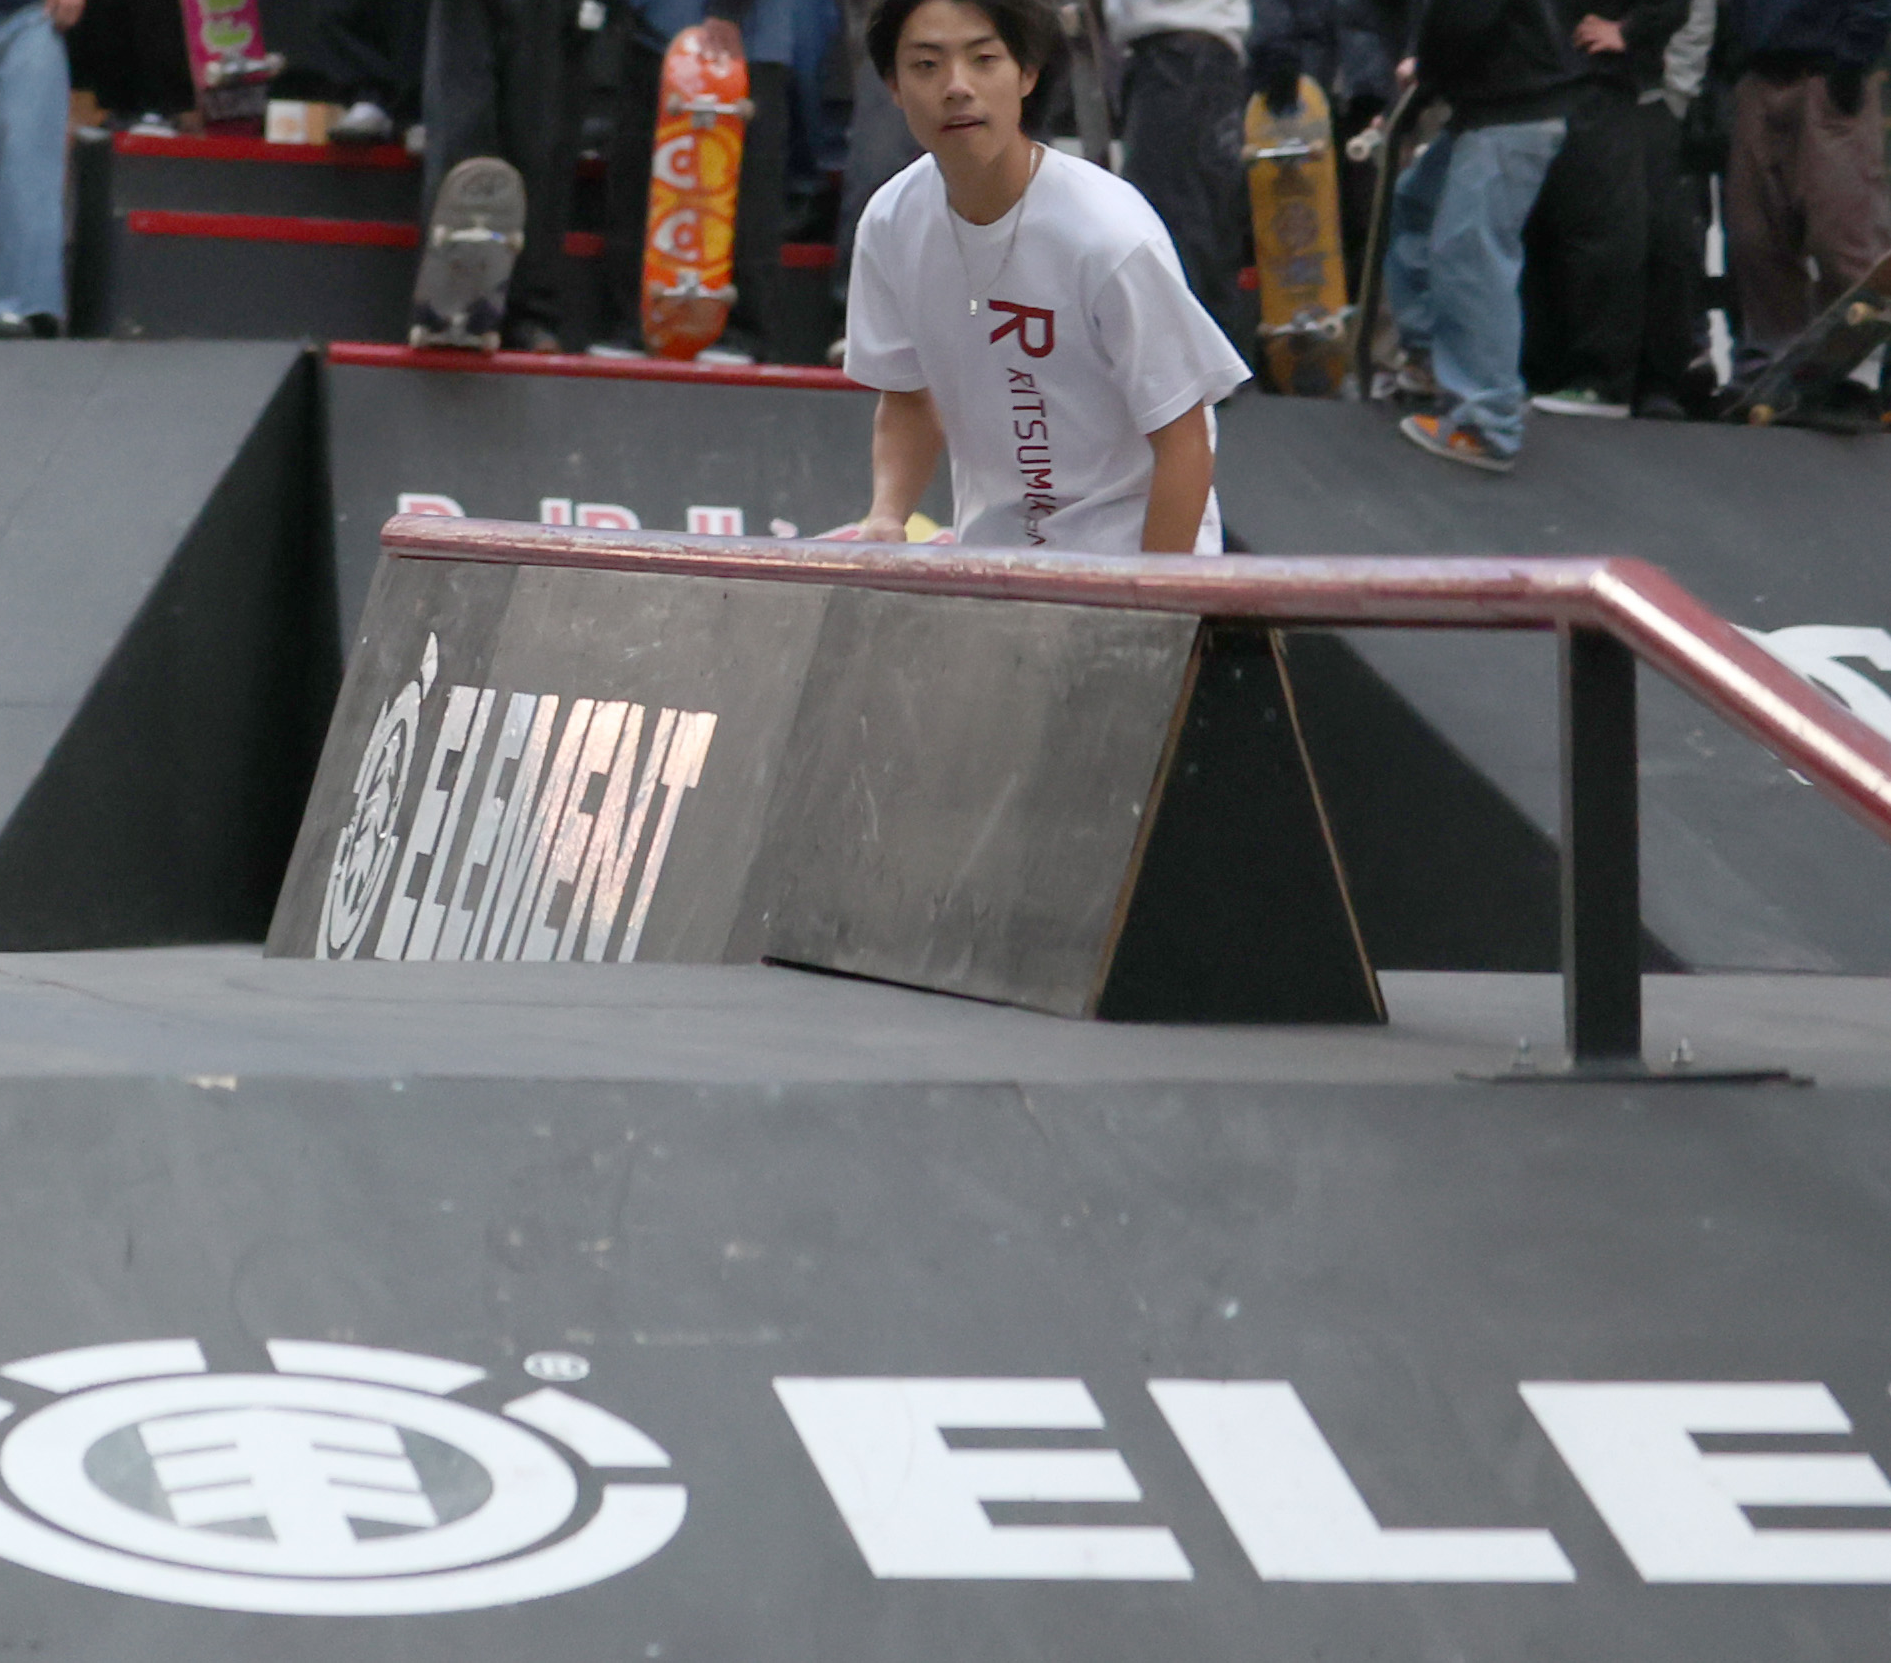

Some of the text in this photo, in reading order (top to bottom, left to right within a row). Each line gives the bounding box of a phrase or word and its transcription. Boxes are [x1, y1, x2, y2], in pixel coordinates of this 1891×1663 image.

[987, 298, 1055, 359] R
[373, 684, 719, 963] ELEMENT
[771, 1374, 1891, 1583] ELE
